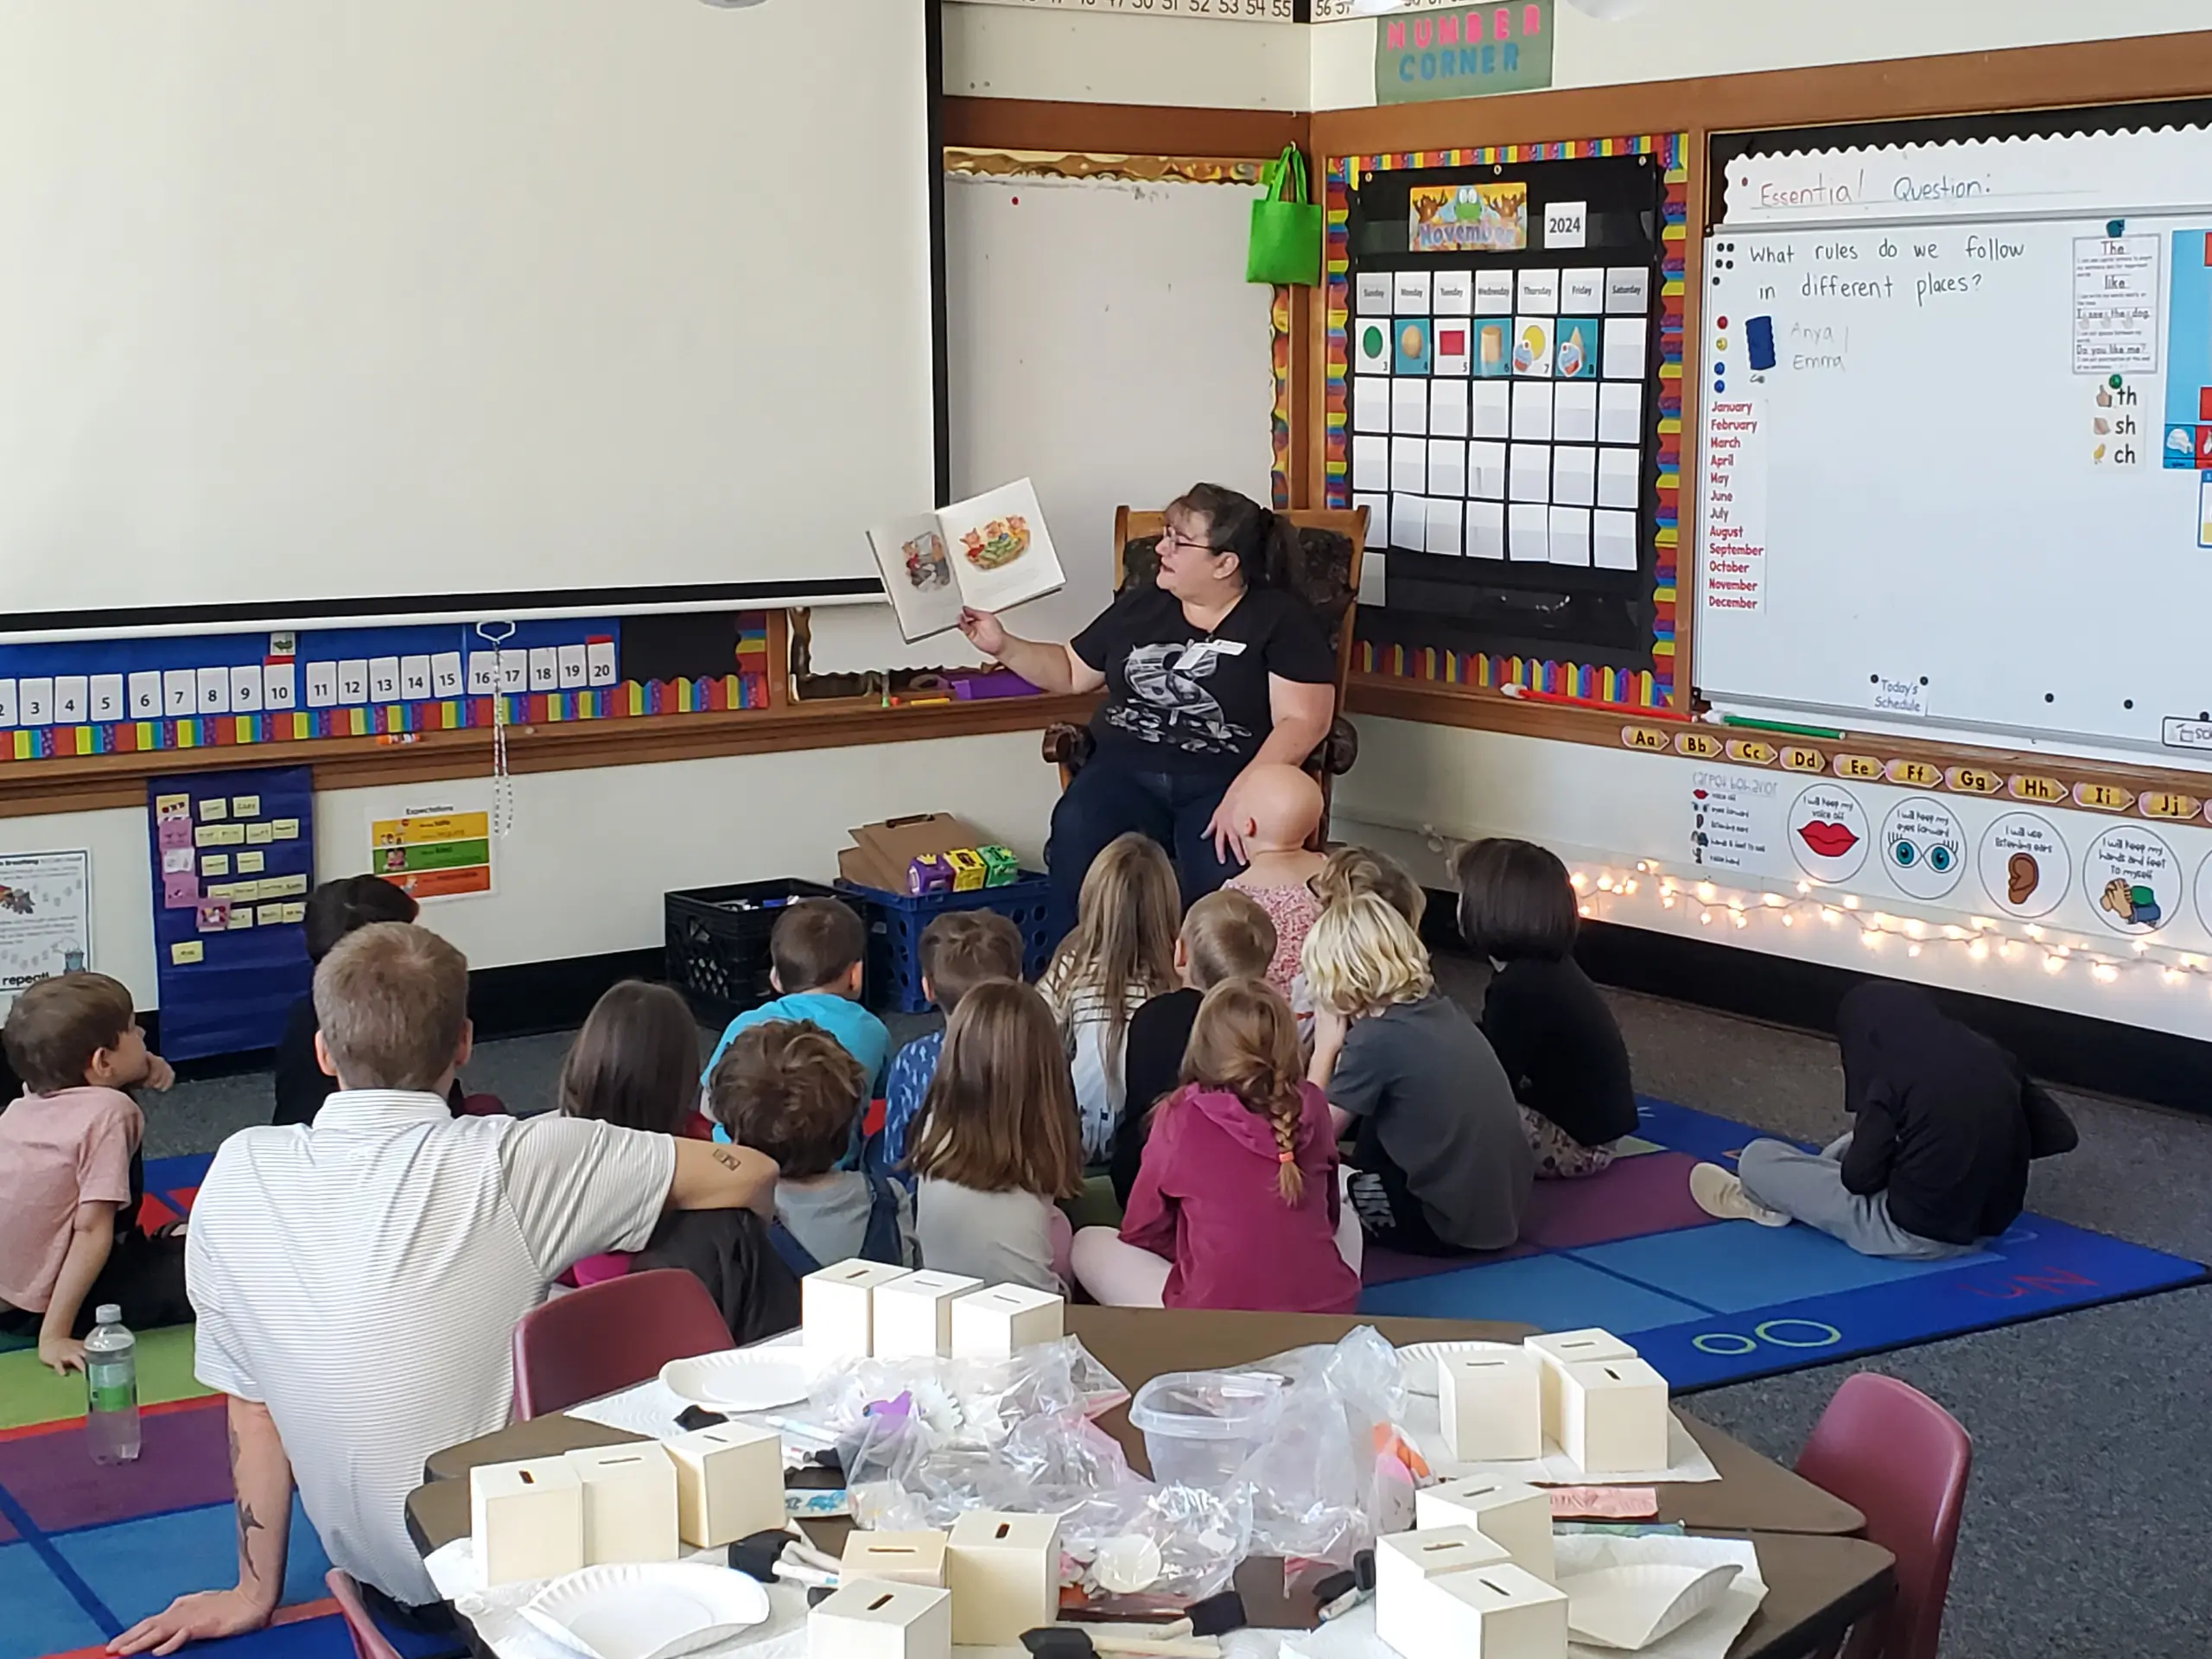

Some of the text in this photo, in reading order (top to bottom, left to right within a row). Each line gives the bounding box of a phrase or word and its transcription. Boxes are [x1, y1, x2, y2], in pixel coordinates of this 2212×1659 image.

[1189, 0, 1210, 12] 52
[1218, 0, 1239, 14] 53
[1245, 0, 1265, 16] 54
[1271, 0, 1291, 17] 55
[1315, 1, 1332, 16] 56
[1388, 4, 1540, 50] NUMBER
[1399, 41, 1519, 83] CORNER
[1761, 168, 1991, 207] Essential Question:
[1420, 213, 1516, 246] November
[1549, 217, 1580, 233] 2024
[1751, 235, 2024, 264] What rules do we follow
[2101, 241, 2125, 255] The
[1759, 271, 1982, 308] in different places?
[2104, 275, 2126, 289] like
[1363, 284, 1641, 298] Sunday Monday Tuesday Wednesday Thursday Friday Saturday
[1382, 361, 1389, 372] 3
[1462, 361, 1468, 372] 5
[1543, 363, 1550, 374] 7
[1792, 353, 1847, 372] Emma
[2116, 385, 2137, 406] th
[1712, 401, 1753, 416] January
[1711, 418, 1758, 434] February
[2114, 415, 2136, 435] sh
[1710, 436, 1741, 448] March
[1710, 454, 1734, 468] April
[2113, 443, 2136, 464] ch
[1710, 472, 1729, 487] May
[1710, 490, 1733, 502] June
[1709, 506, 1729, 523] July
[1709, 525, 1744, 541] August
[1709, 543, 1764, 557] September
[1709, 560, 1751, 573] October
[1709, 578, 1758, 592] November
[1708, 595, 1758, 609] December
[30, 702, 40, 715] 3
[65, 700, 75, 712] 4
[101, 697, 111, 709] 5
[140, 694, 150, 708] 6
[175, 691, 184, 704] 7
[207, 690, 217, 702] 8
[240, 688, 251, 701] 9
[270, 687, 288, 701] 10
[314, 683, 327, 696] 11
[344, 681, 360, 694] 12
[377, 679, 392, 693] 13
[408, 677, 423, 690] 14
[439, 673, 455, 687] 15
[475, 671, 491, 684] 16
[505, 670, 520, 683] 17
[536, 668, 552, 681] 18
[565, 664, 581, 678] 19
[594, 664, 610, 677] 20
[1881, 678, 1919, 697] Today's
[1874, 696, 1921, 712] Schedule
[1635, 730, 2178, 816] Aa Bb Cc Dd Ee Ff Gg Hh Ii Jj
[1811, 810, 1831, 819] voice
